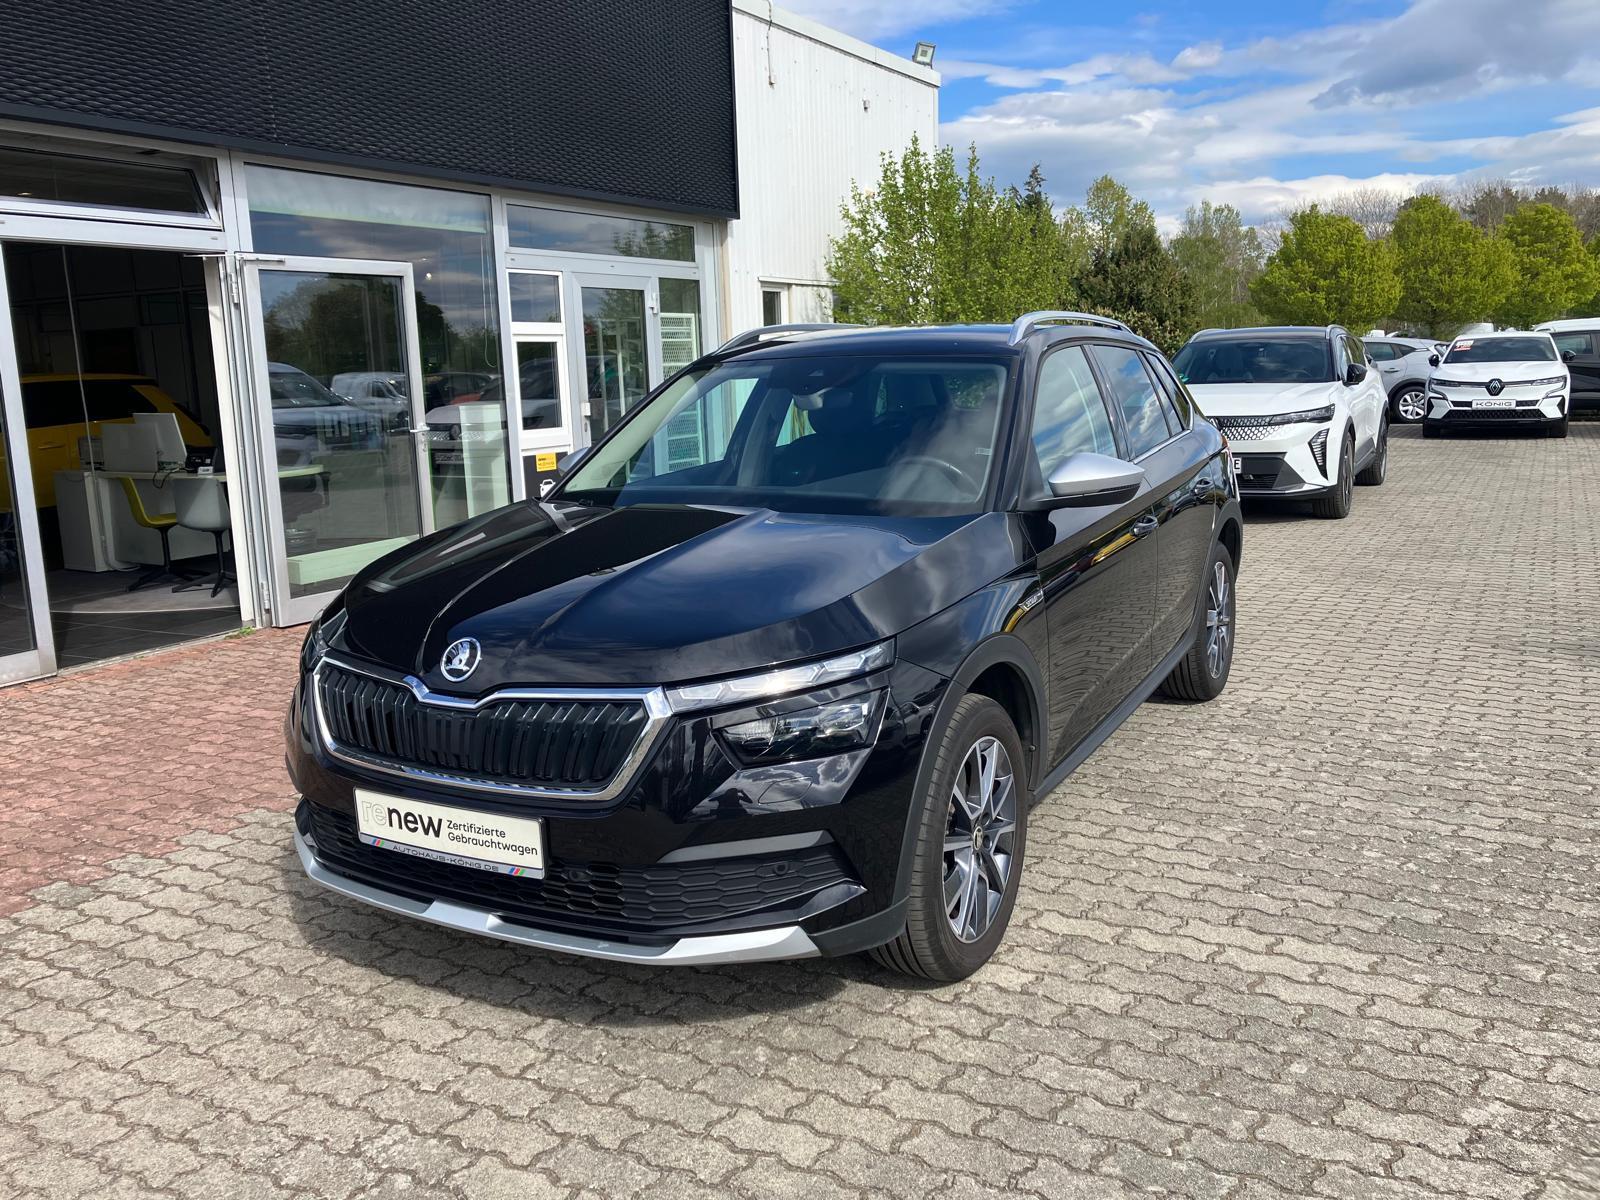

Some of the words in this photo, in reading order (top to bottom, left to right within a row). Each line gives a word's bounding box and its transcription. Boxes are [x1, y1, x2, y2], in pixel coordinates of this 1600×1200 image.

[361, 800, 443, 838] renew
[446, 819, 506, 838] Zertifizierte
[447, 832, 538, 856] Gebrauchtwagen
